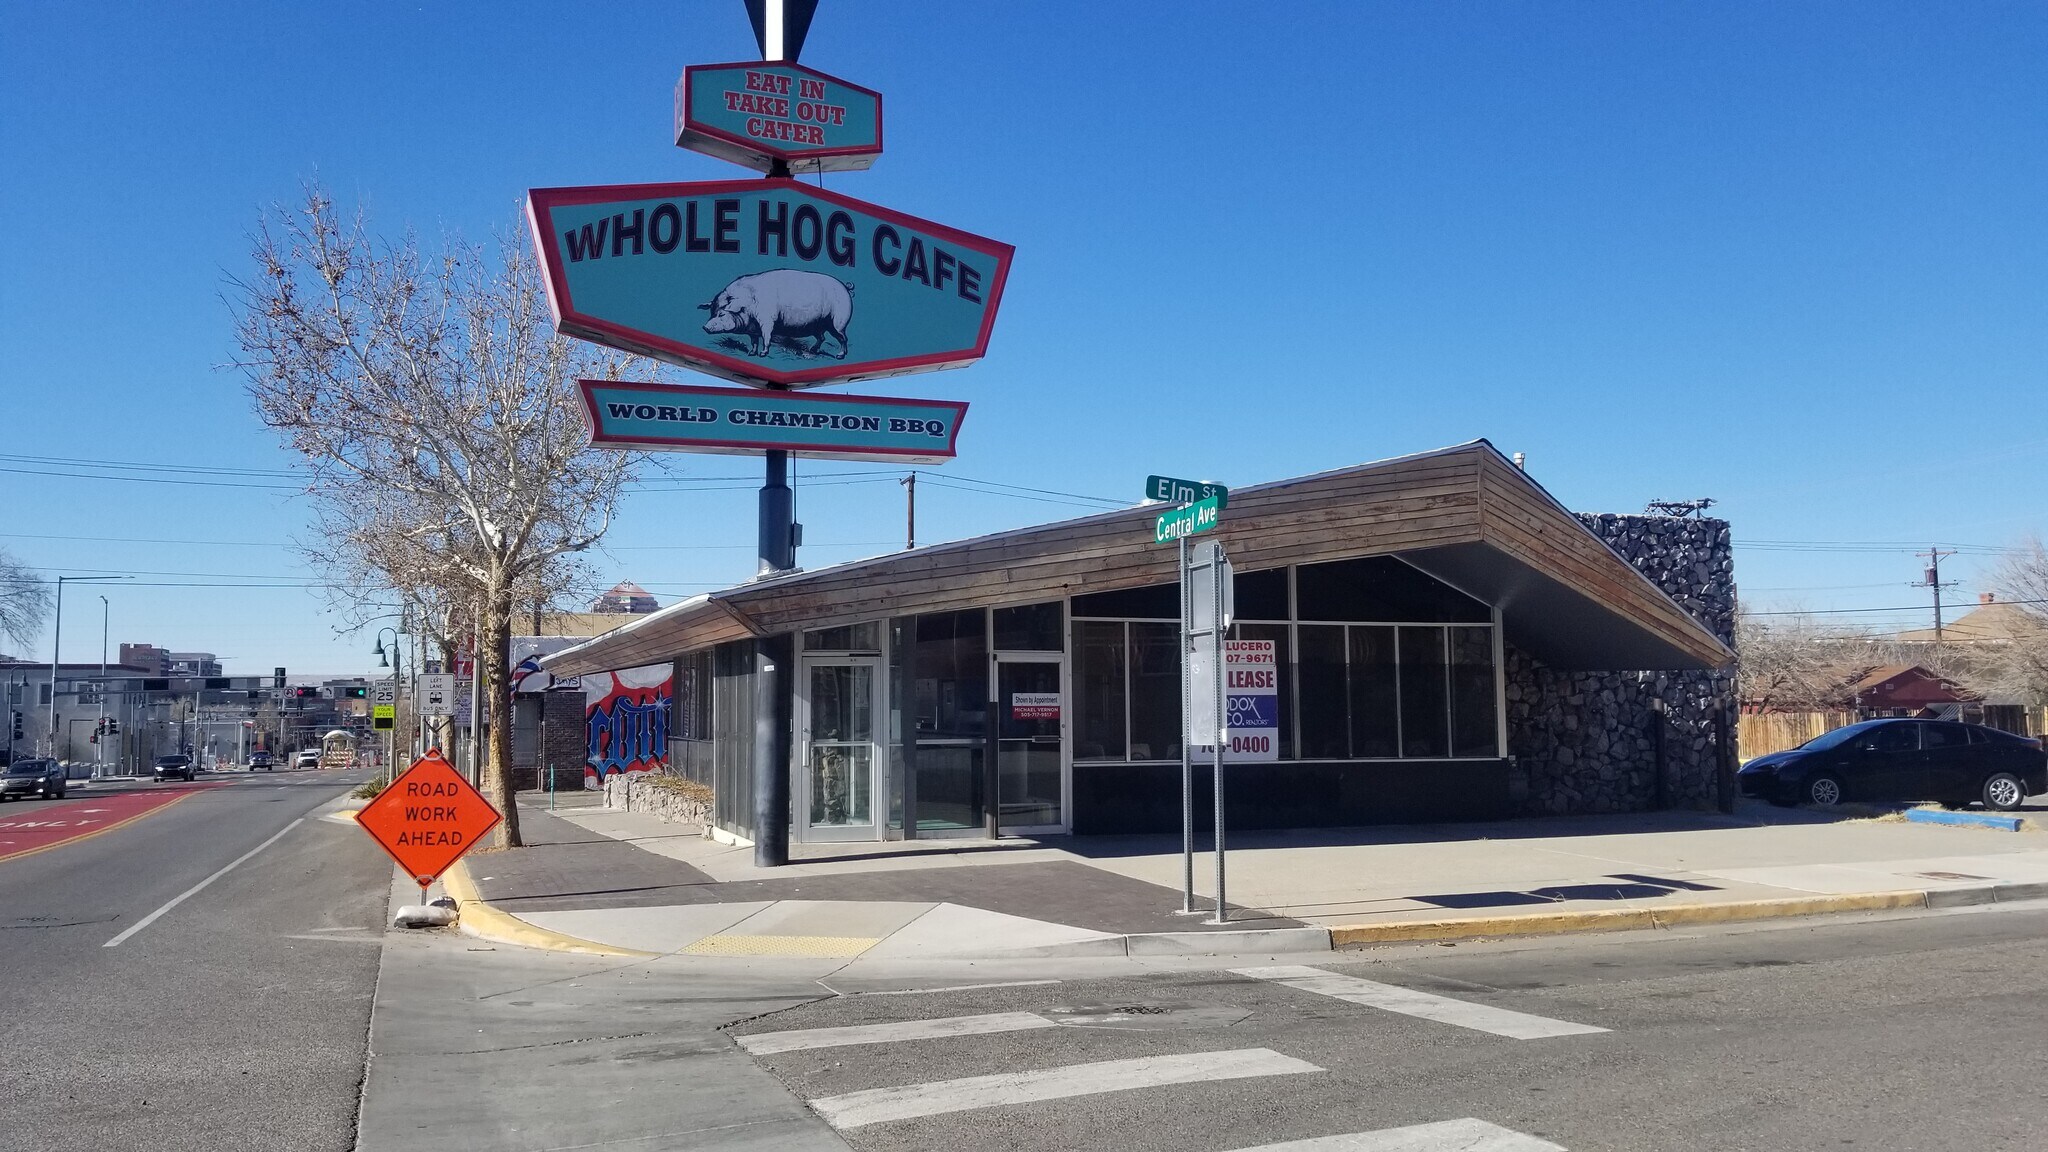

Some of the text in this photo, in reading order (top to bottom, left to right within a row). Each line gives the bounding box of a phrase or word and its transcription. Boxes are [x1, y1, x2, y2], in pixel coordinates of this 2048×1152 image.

[746, 71, 825, 101] EAT IN
[724, 91, 846, 126] TAKE OUT
[746, 117, 825, 145] CATER
[564, 200, 982, 304] WHOLE HOG CAFE
[606, 402, 946, 438] WORLD CHAMPION BBQ
[1157, 479, 1217, 504] Elm St
[1157, 506, 1216, 541] Central Ave
[1226, 642, 1272, 651] LUCERO
[1226, 654, 1274, 663] 07-9671
[1228, 670, 1274, 688] LEASE
[377, 692, 394, 701] 25
[407, 782, 458, 797] ROAD
[405, 806, 457, 821] WORK
[397, 831, 463, 846] AHEAD
